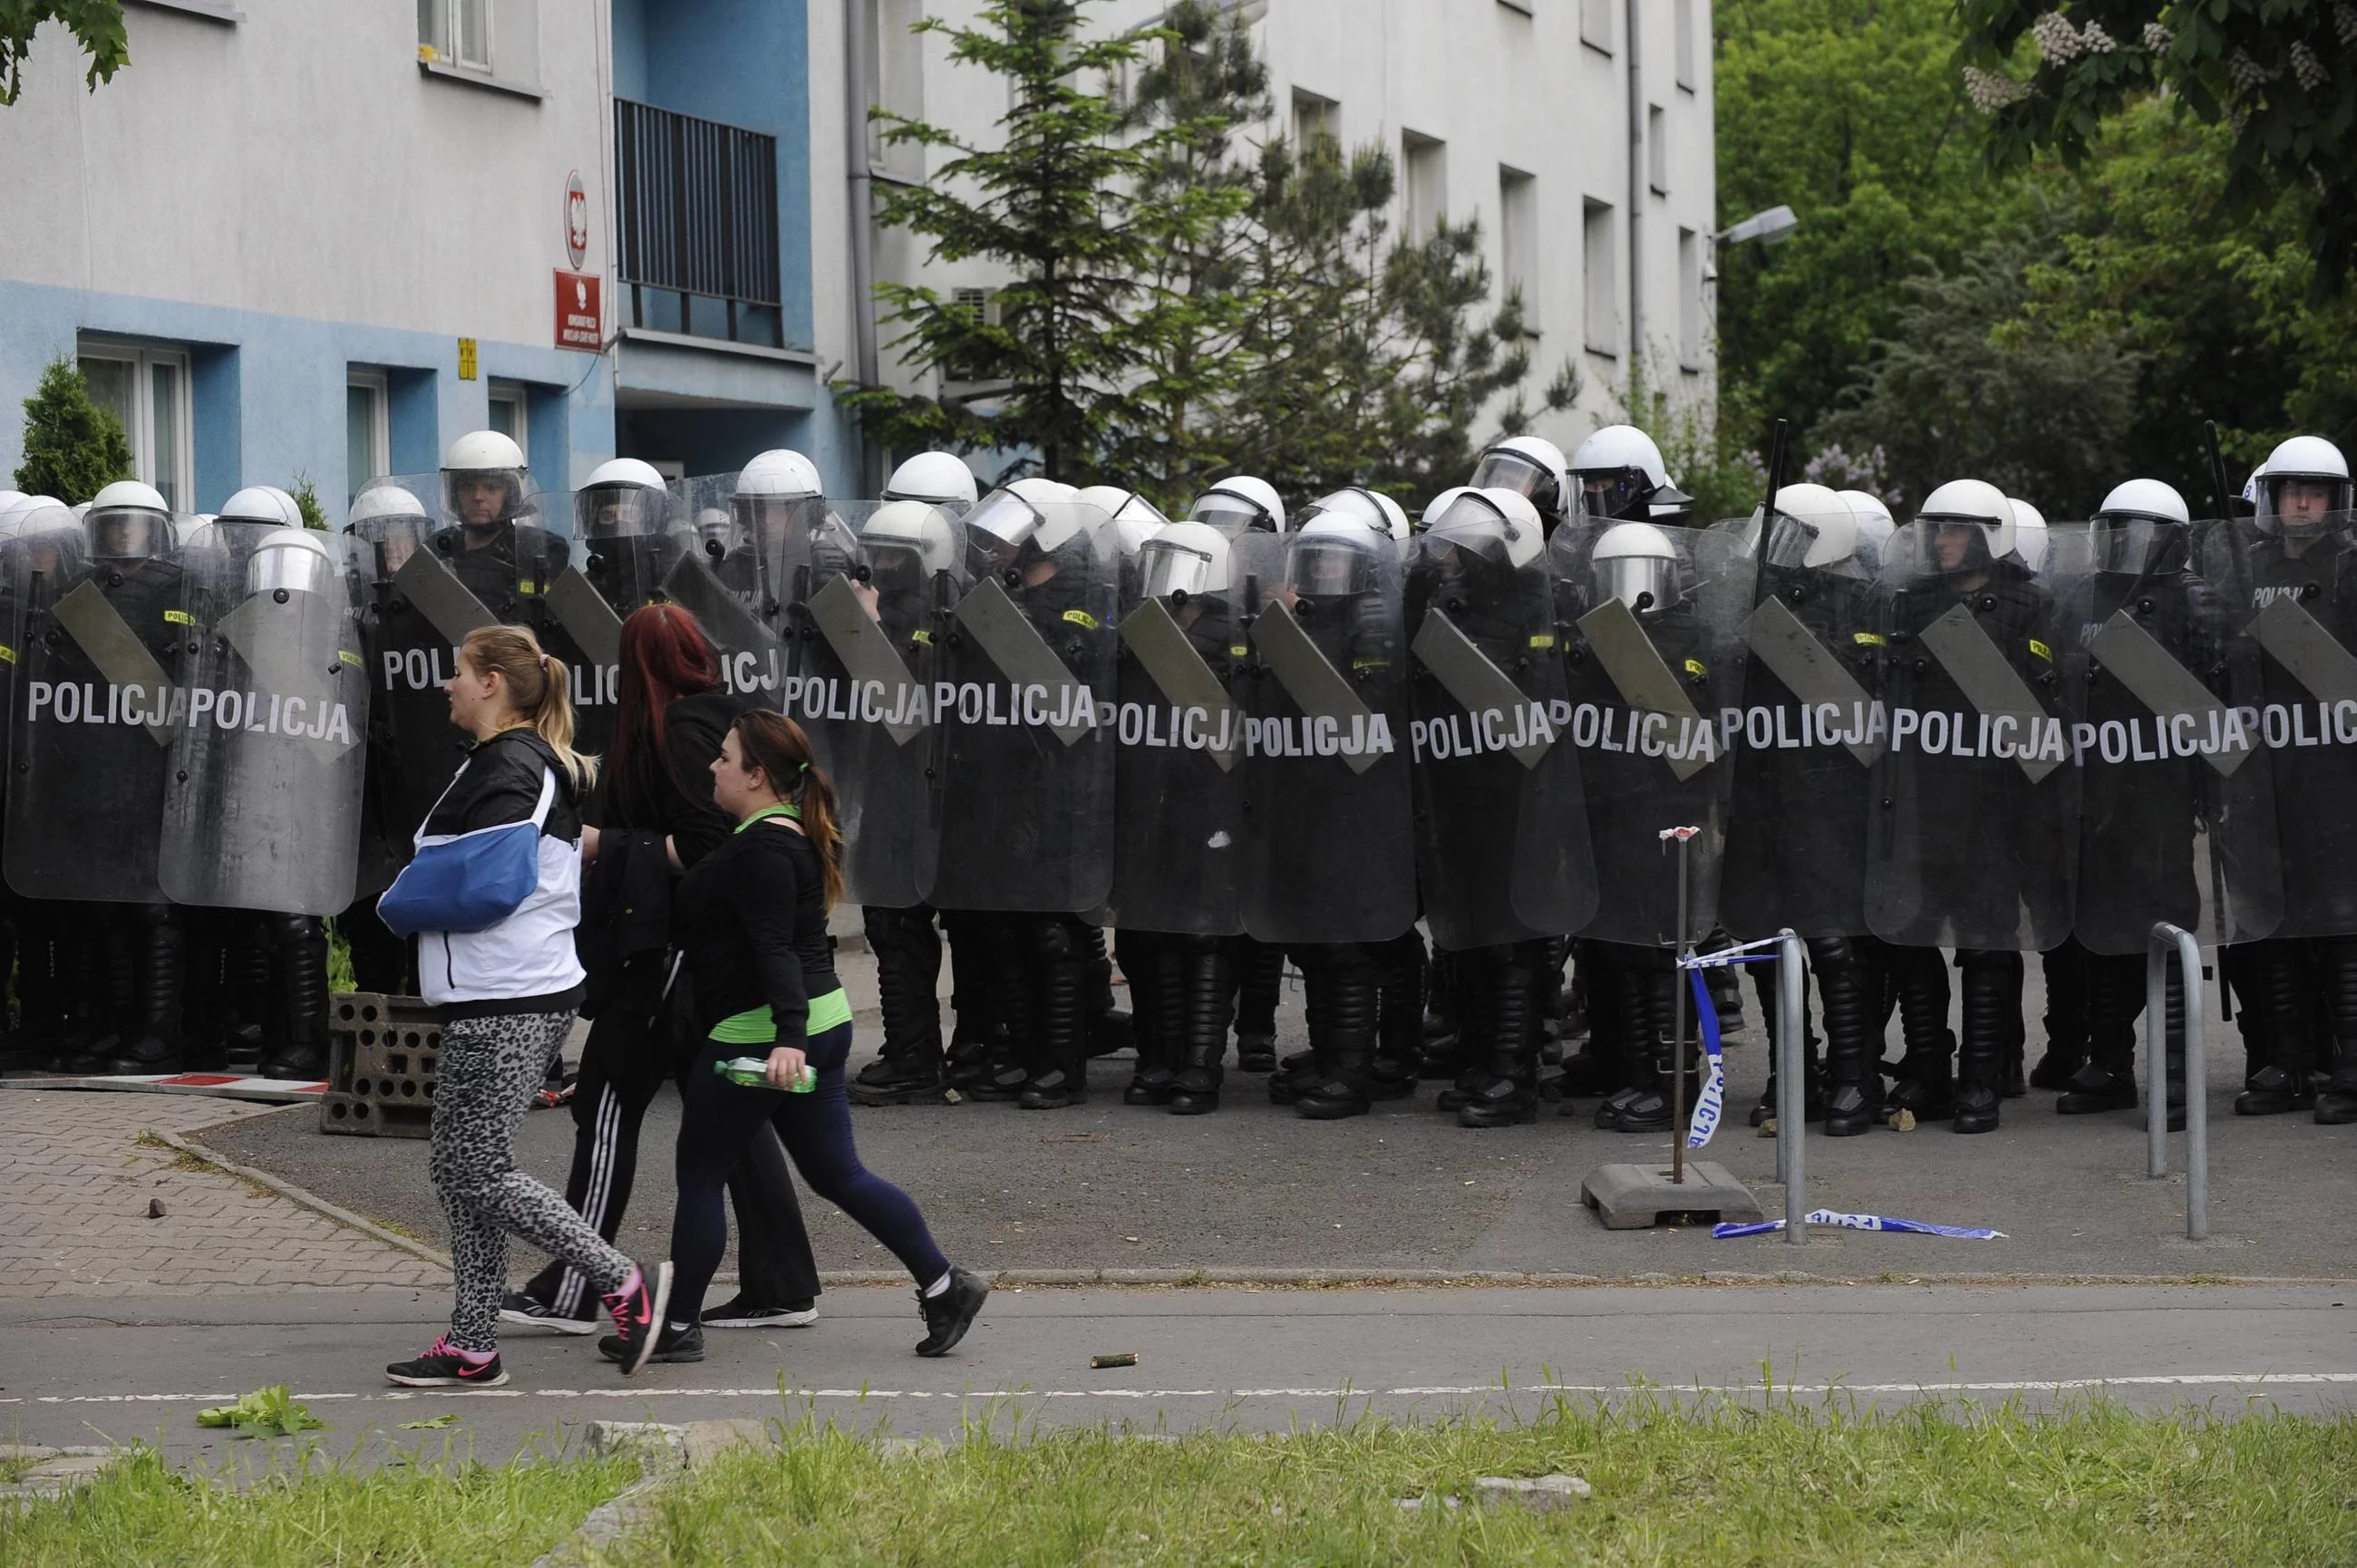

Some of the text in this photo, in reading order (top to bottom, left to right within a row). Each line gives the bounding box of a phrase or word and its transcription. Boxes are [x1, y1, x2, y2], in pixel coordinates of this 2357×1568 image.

[383, 646, 461, 692] POLI
[28, 682, 185, 727] POLICJA
[189, 688, 350, 744] POLICJA
[783, 676, 929, 726] POLICJA
[934, 682, 1096, 728] POLICJA
[1722, 700, 1888, 750] POLICJA
[1246, 712, 1393, 757] POLICJA
[1411, 701, 1556, 763] POLICJA
[1548, 699, 1715, 762] POLICJA
[1891, 707, 2065, 762] POLICJA
[2072, 707, 2249, 767] POLICJA
